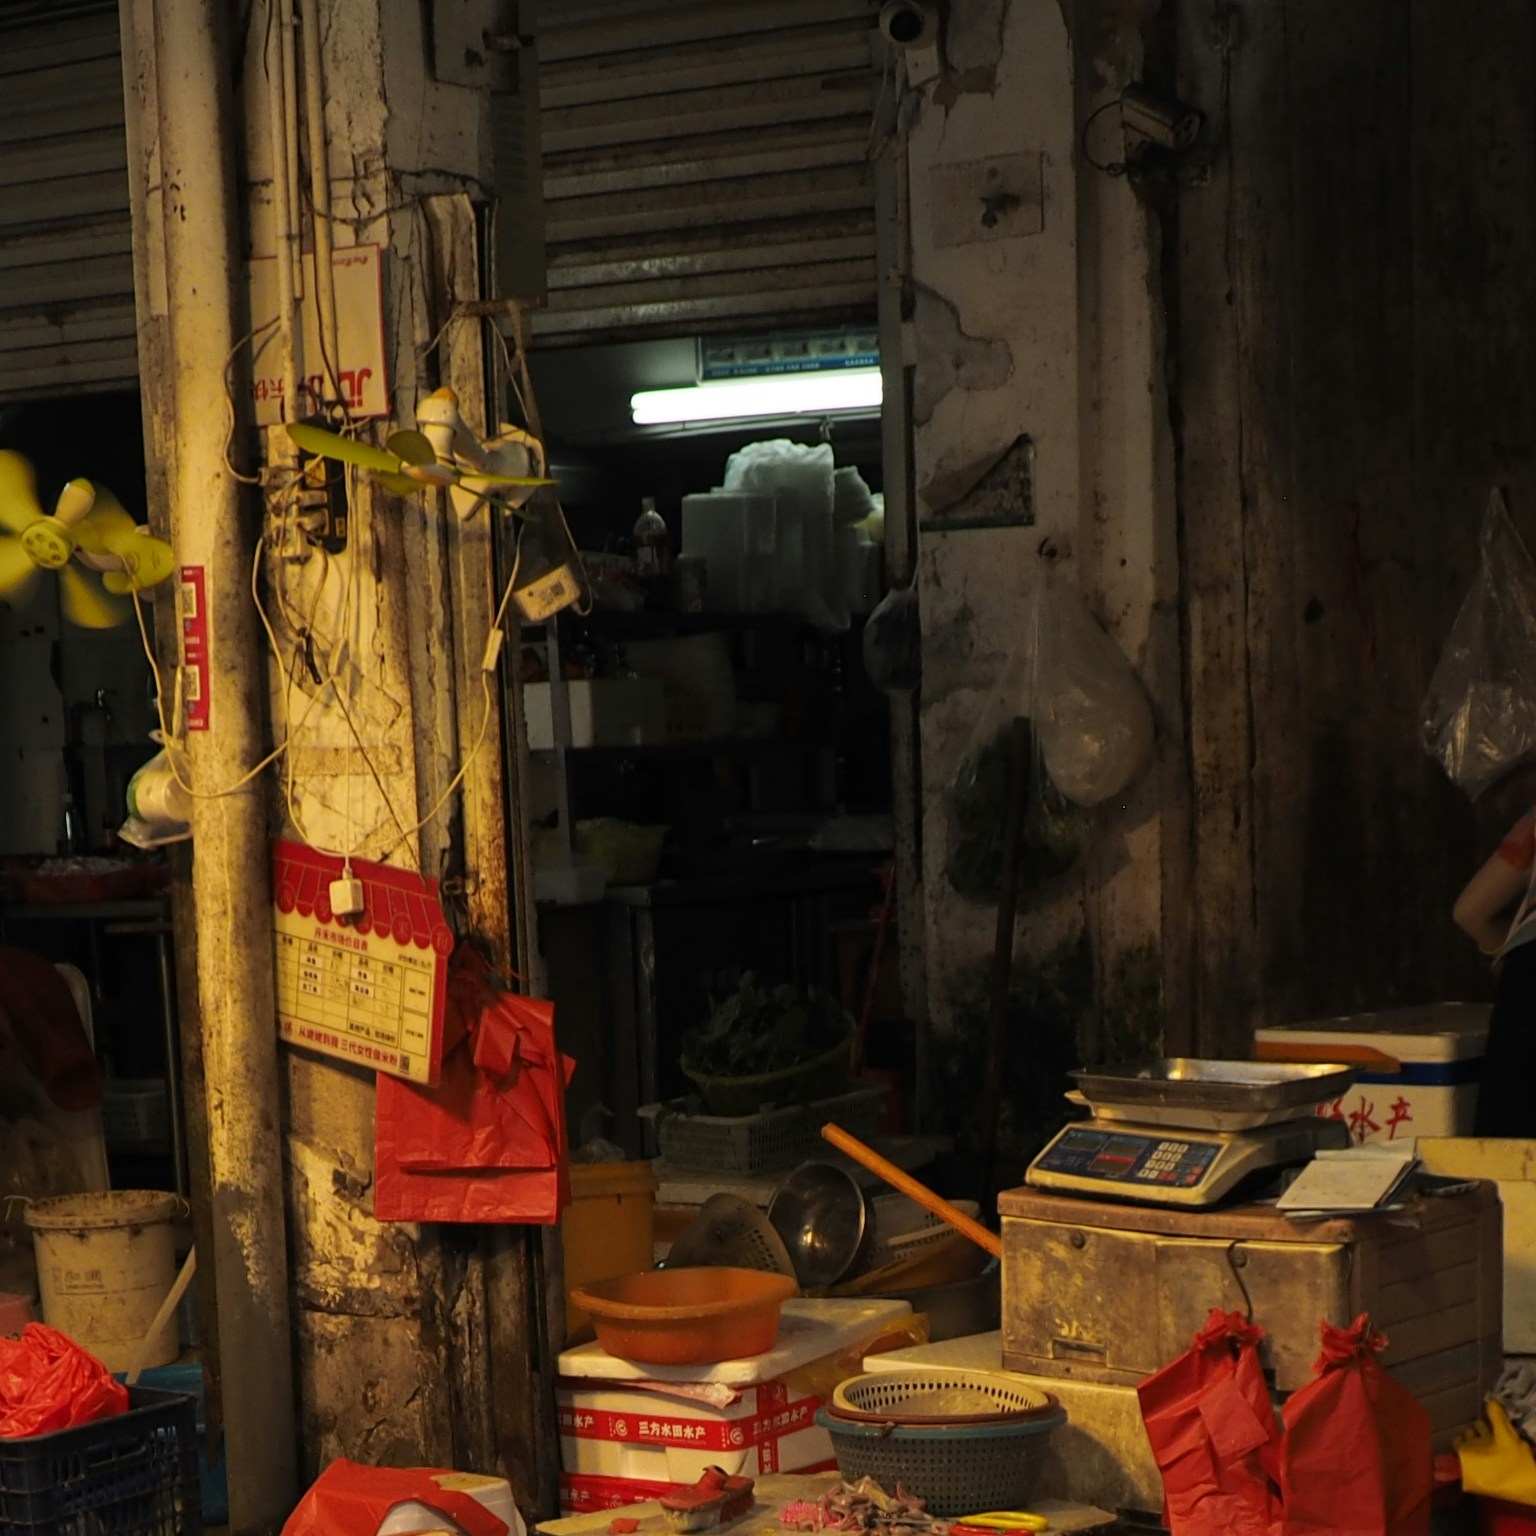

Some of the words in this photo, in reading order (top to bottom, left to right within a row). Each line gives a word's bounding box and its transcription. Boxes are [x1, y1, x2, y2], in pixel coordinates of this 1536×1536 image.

[638, 1420, 706, 1440] 三方水田水产
